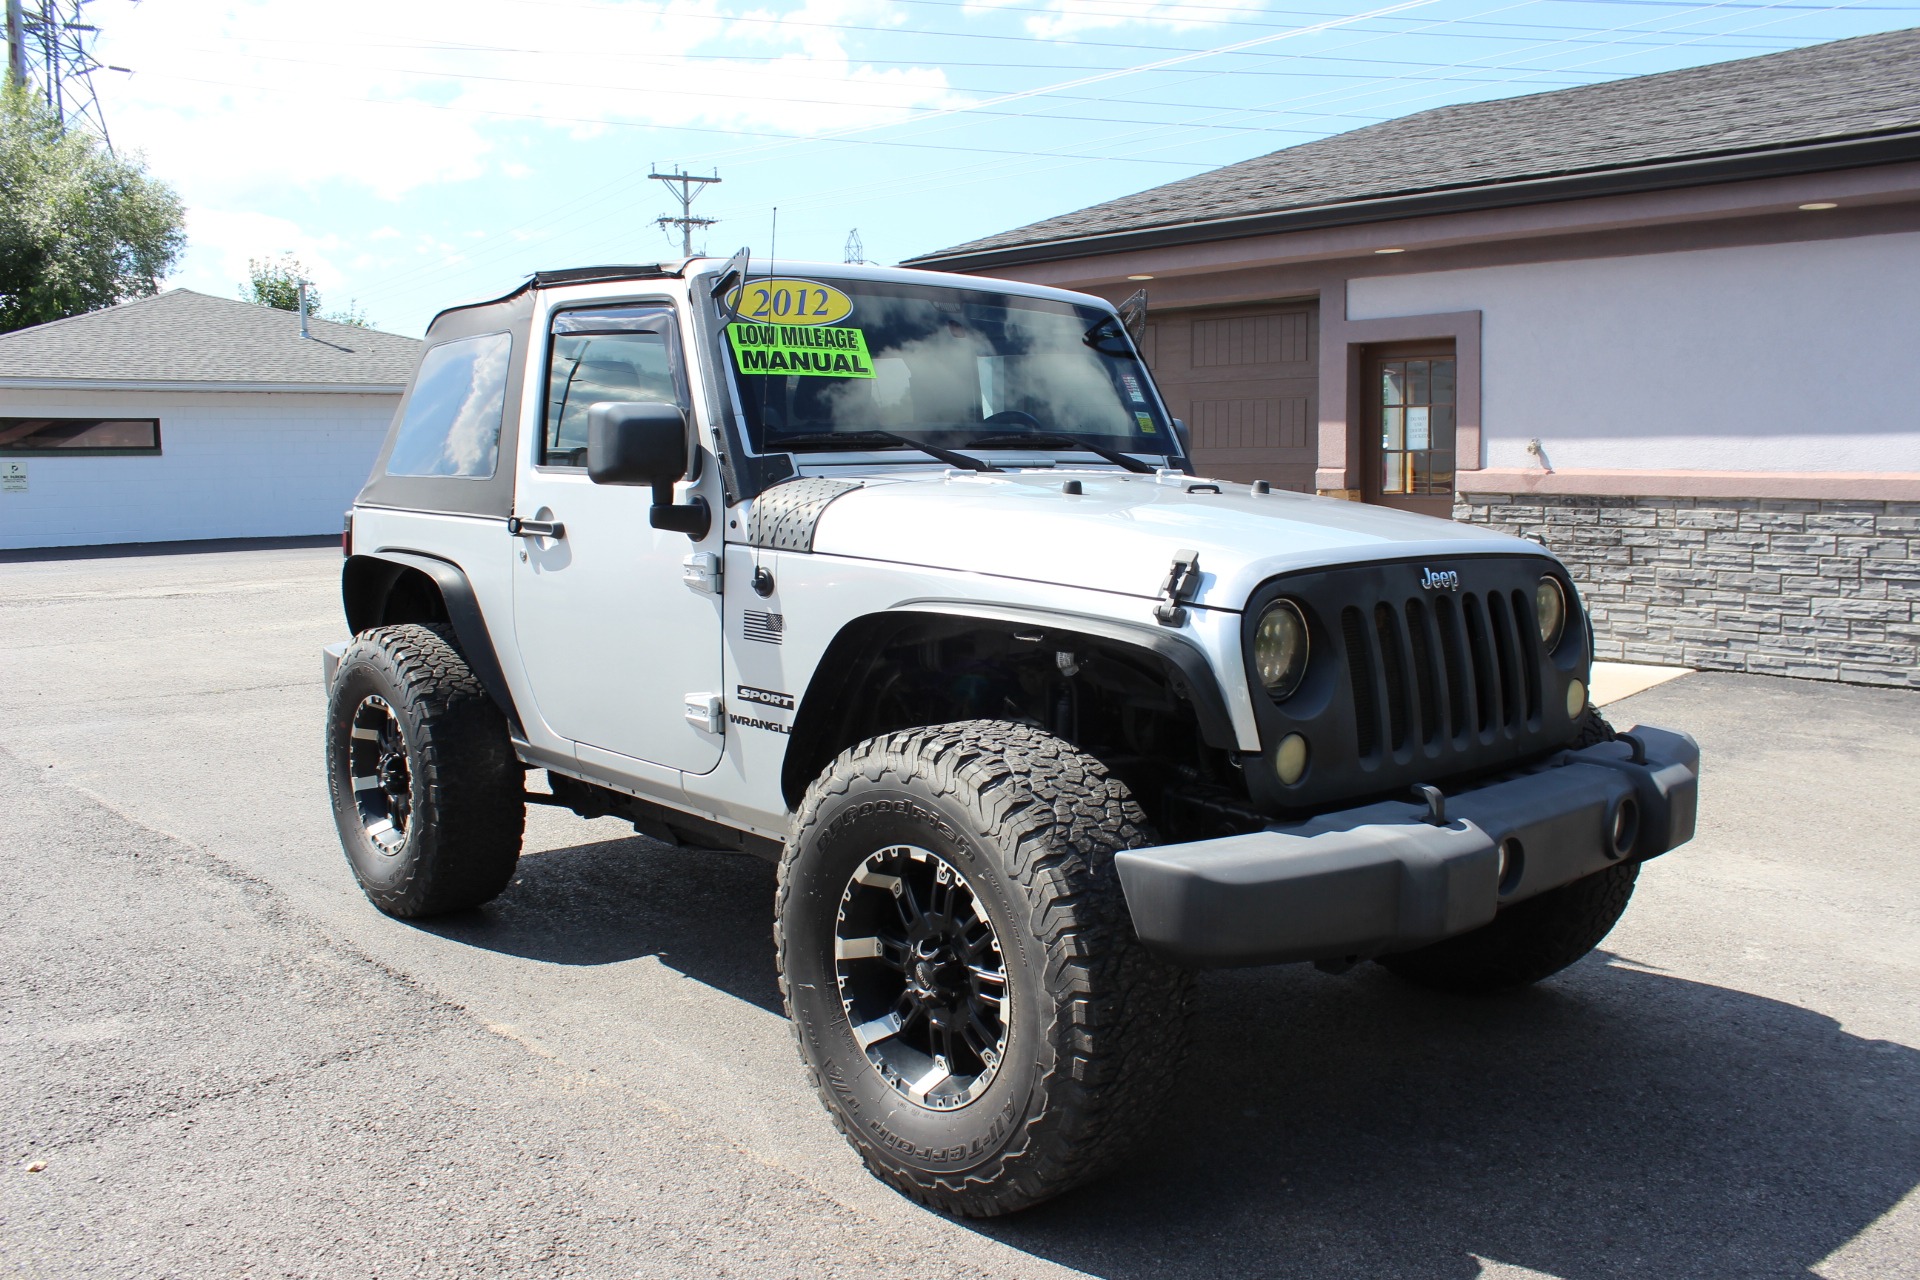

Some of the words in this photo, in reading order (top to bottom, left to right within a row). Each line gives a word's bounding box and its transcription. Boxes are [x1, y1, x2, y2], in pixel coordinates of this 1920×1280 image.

[752, 288, 829, 317] 2012
[736, 324, 775, 346] LOW
[781, 326, 858, 350] MILEAGE
[742, 350, 870, 374] MANUAL
[1421, 567, 1460, 592] Jeep
[739, 688, 794, 706] SPORT
